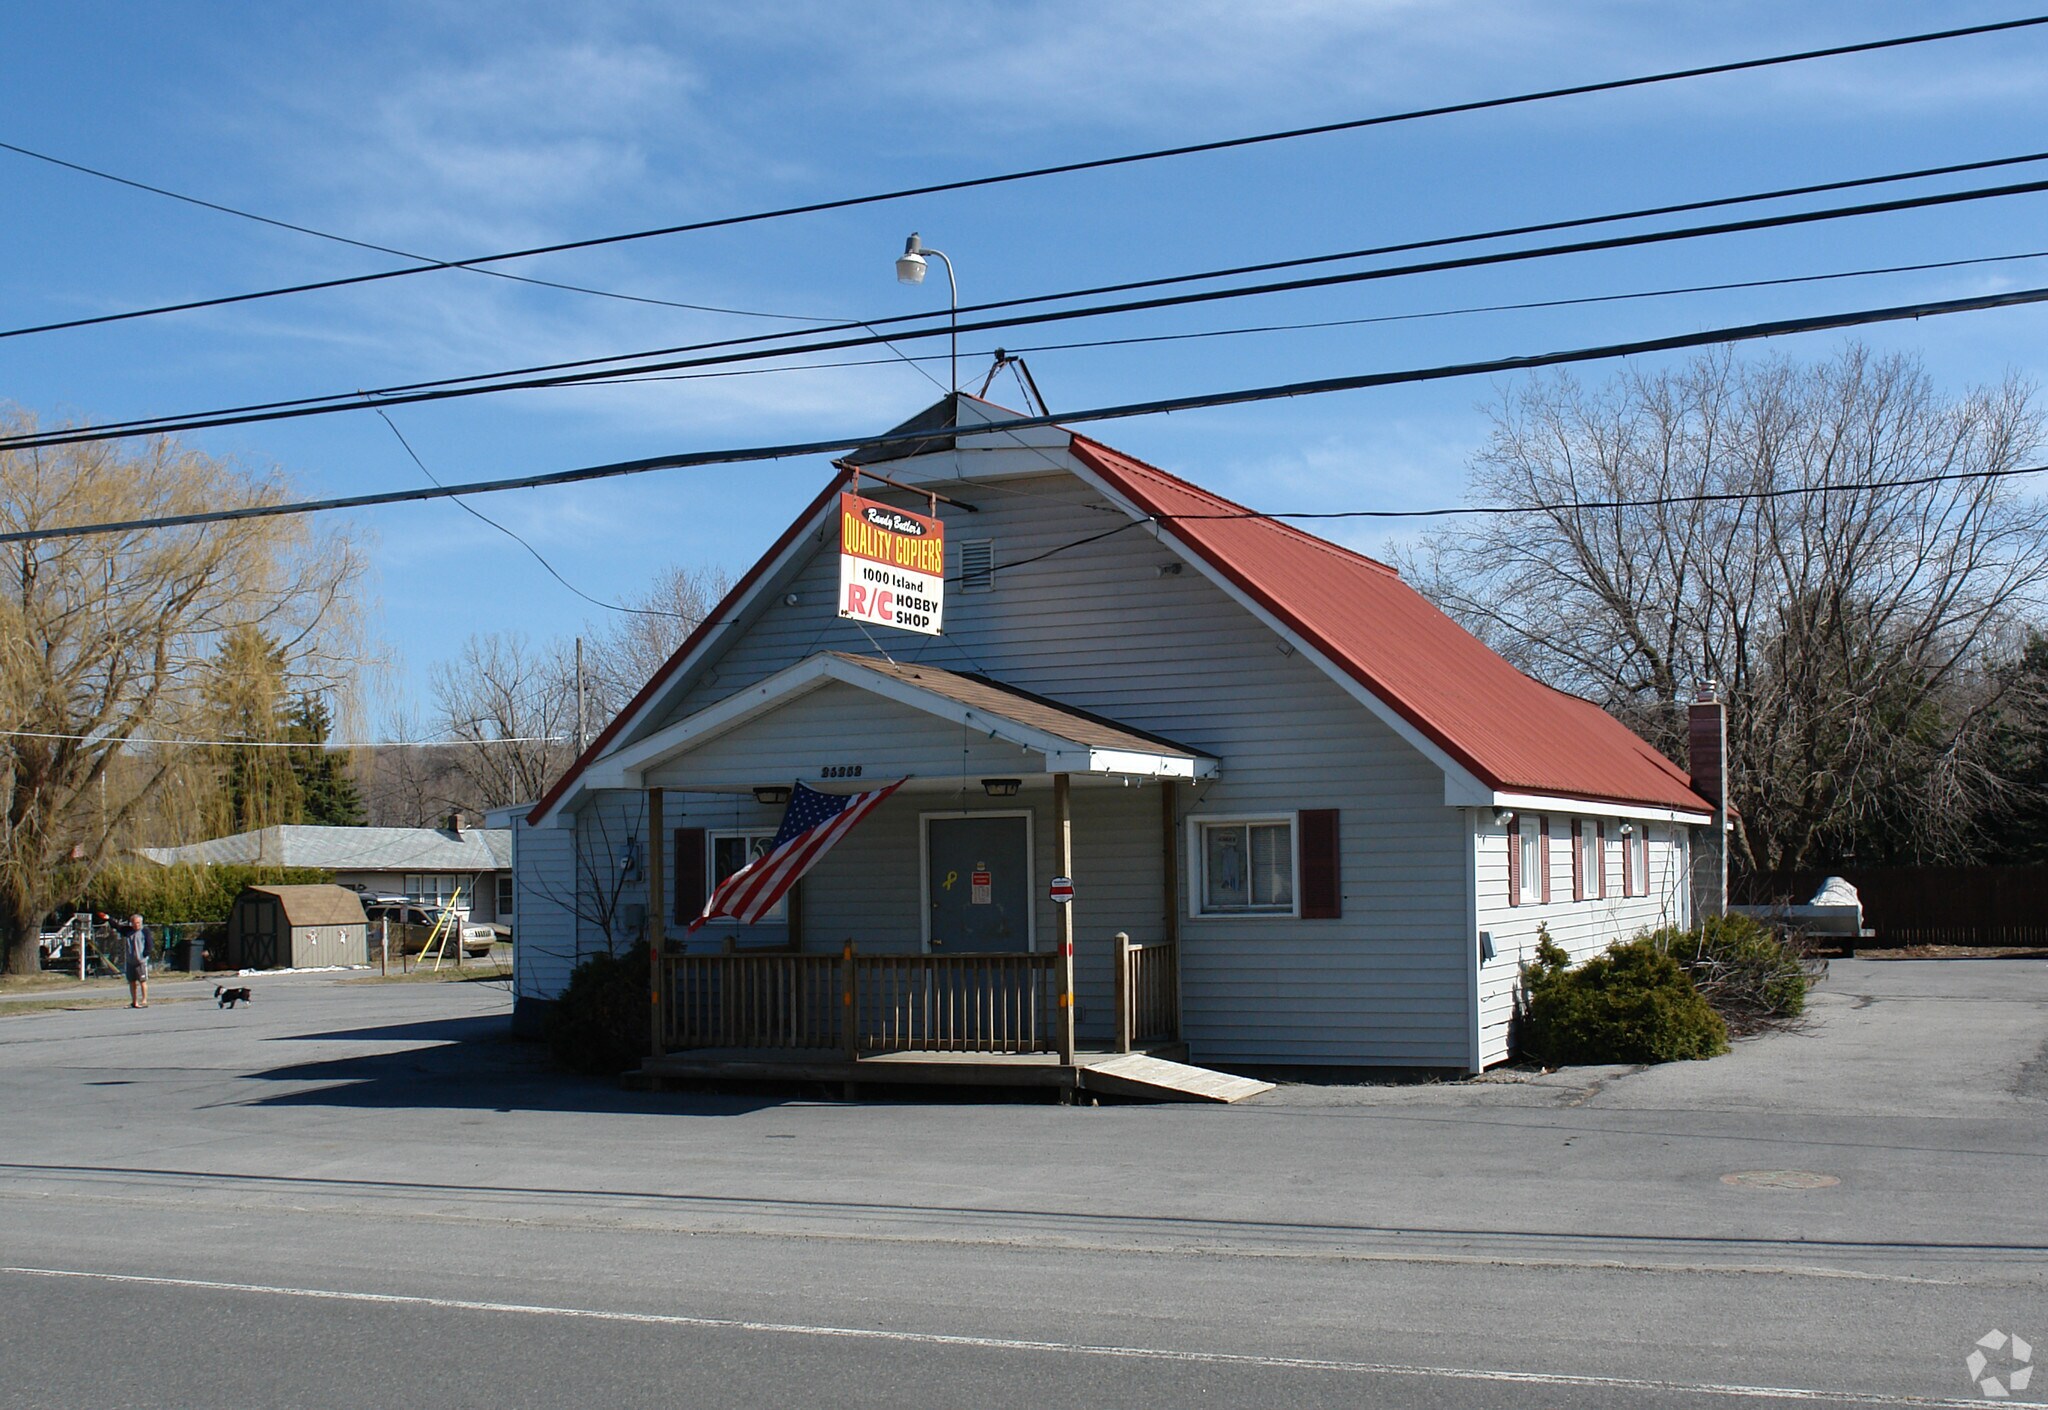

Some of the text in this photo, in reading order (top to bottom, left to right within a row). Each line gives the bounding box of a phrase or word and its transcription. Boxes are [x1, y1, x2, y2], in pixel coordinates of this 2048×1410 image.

[867, 508, 921, 535] Randy Butler's
[844, 512, 942, 573] QUALITY COPIERS
[863, 567, 923, 593] 1000 Island
[848, 583, 893, 621] R/C
[896, 593, 938, 613] HOBBY
[896, 611, 930, 628] SHOP
